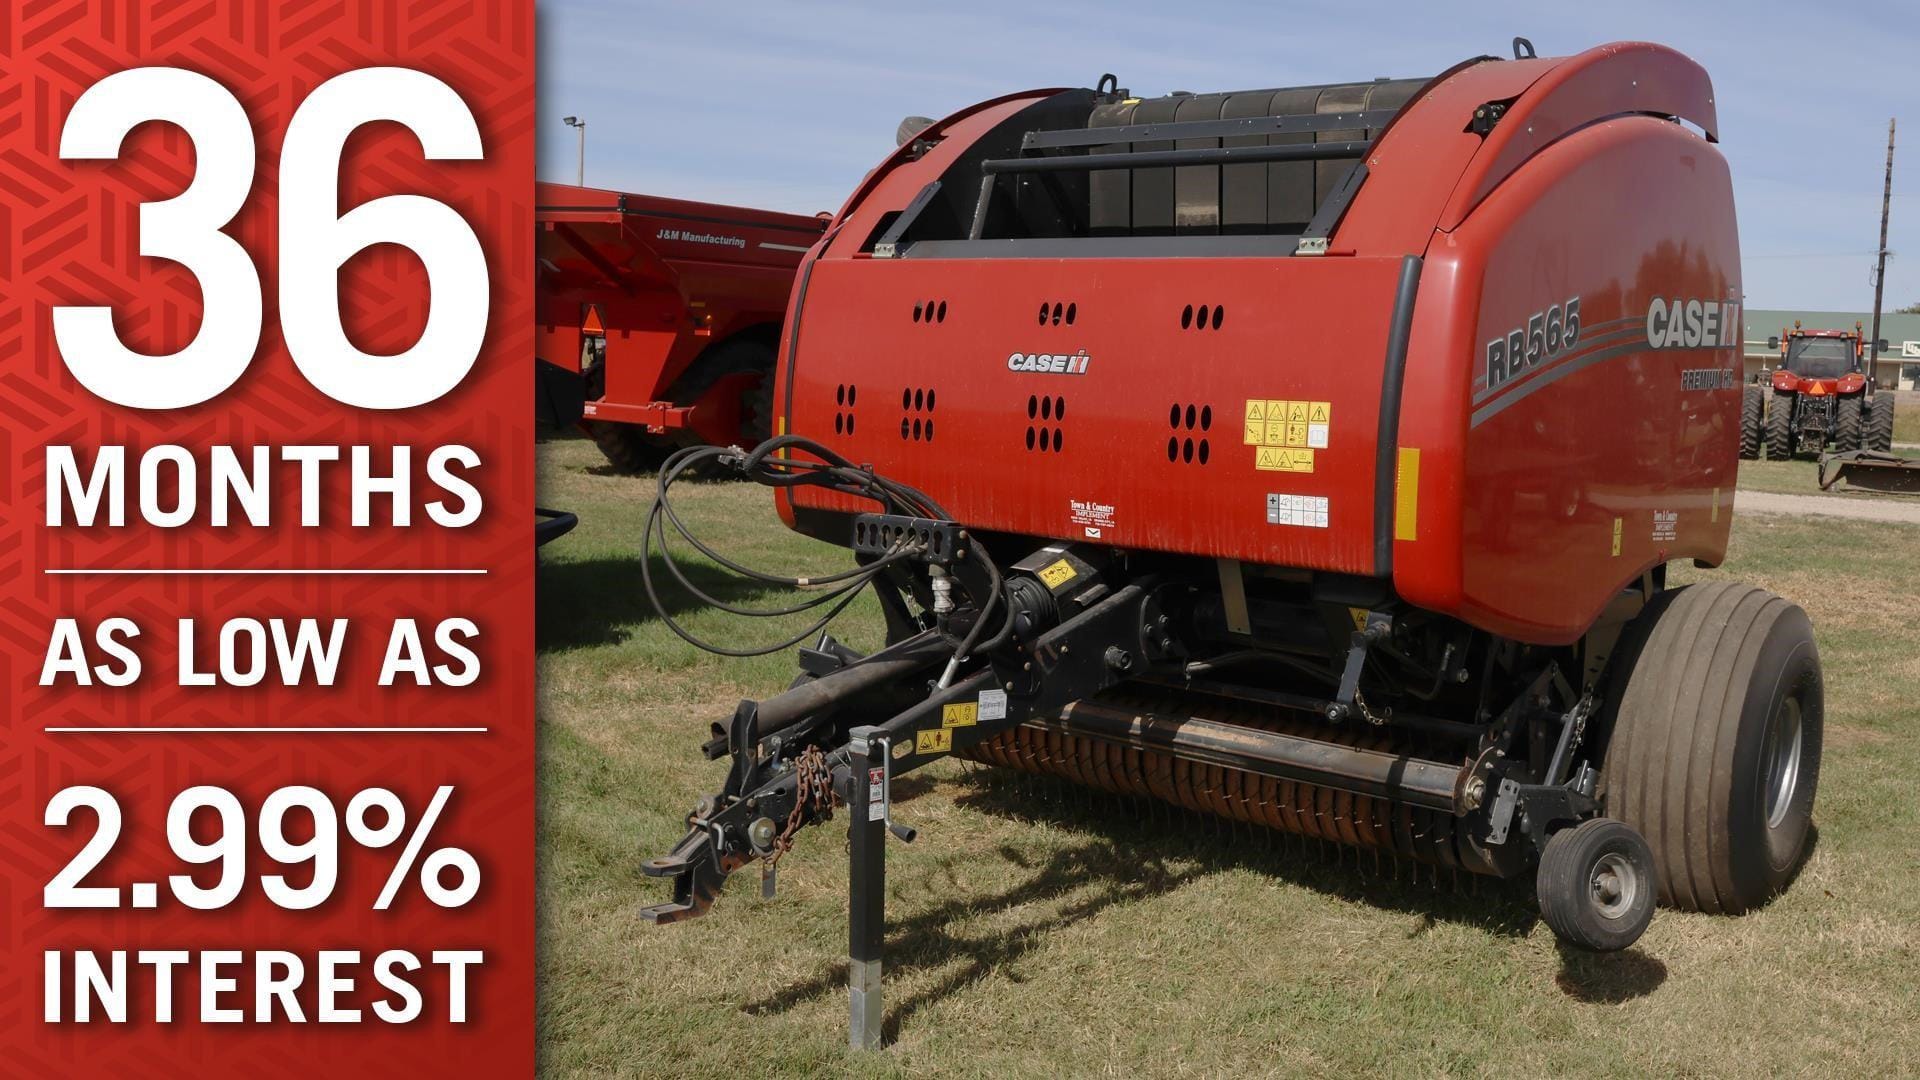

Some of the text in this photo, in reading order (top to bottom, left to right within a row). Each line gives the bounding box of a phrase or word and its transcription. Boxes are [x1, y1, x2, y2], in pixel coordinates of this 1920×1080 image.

[656, 229, 746, 249] J&M Manufacturing
[1647, 297, 1719, 348] CASE
[1486, 296, 1580, 390] RB565
[1007, 353, 1067, 373] CASE
[1681, 368, 1721, 391] PREMIUM
[1070, 499, 1085, 510] Town
[1092, 502, 1114, 515] Country
